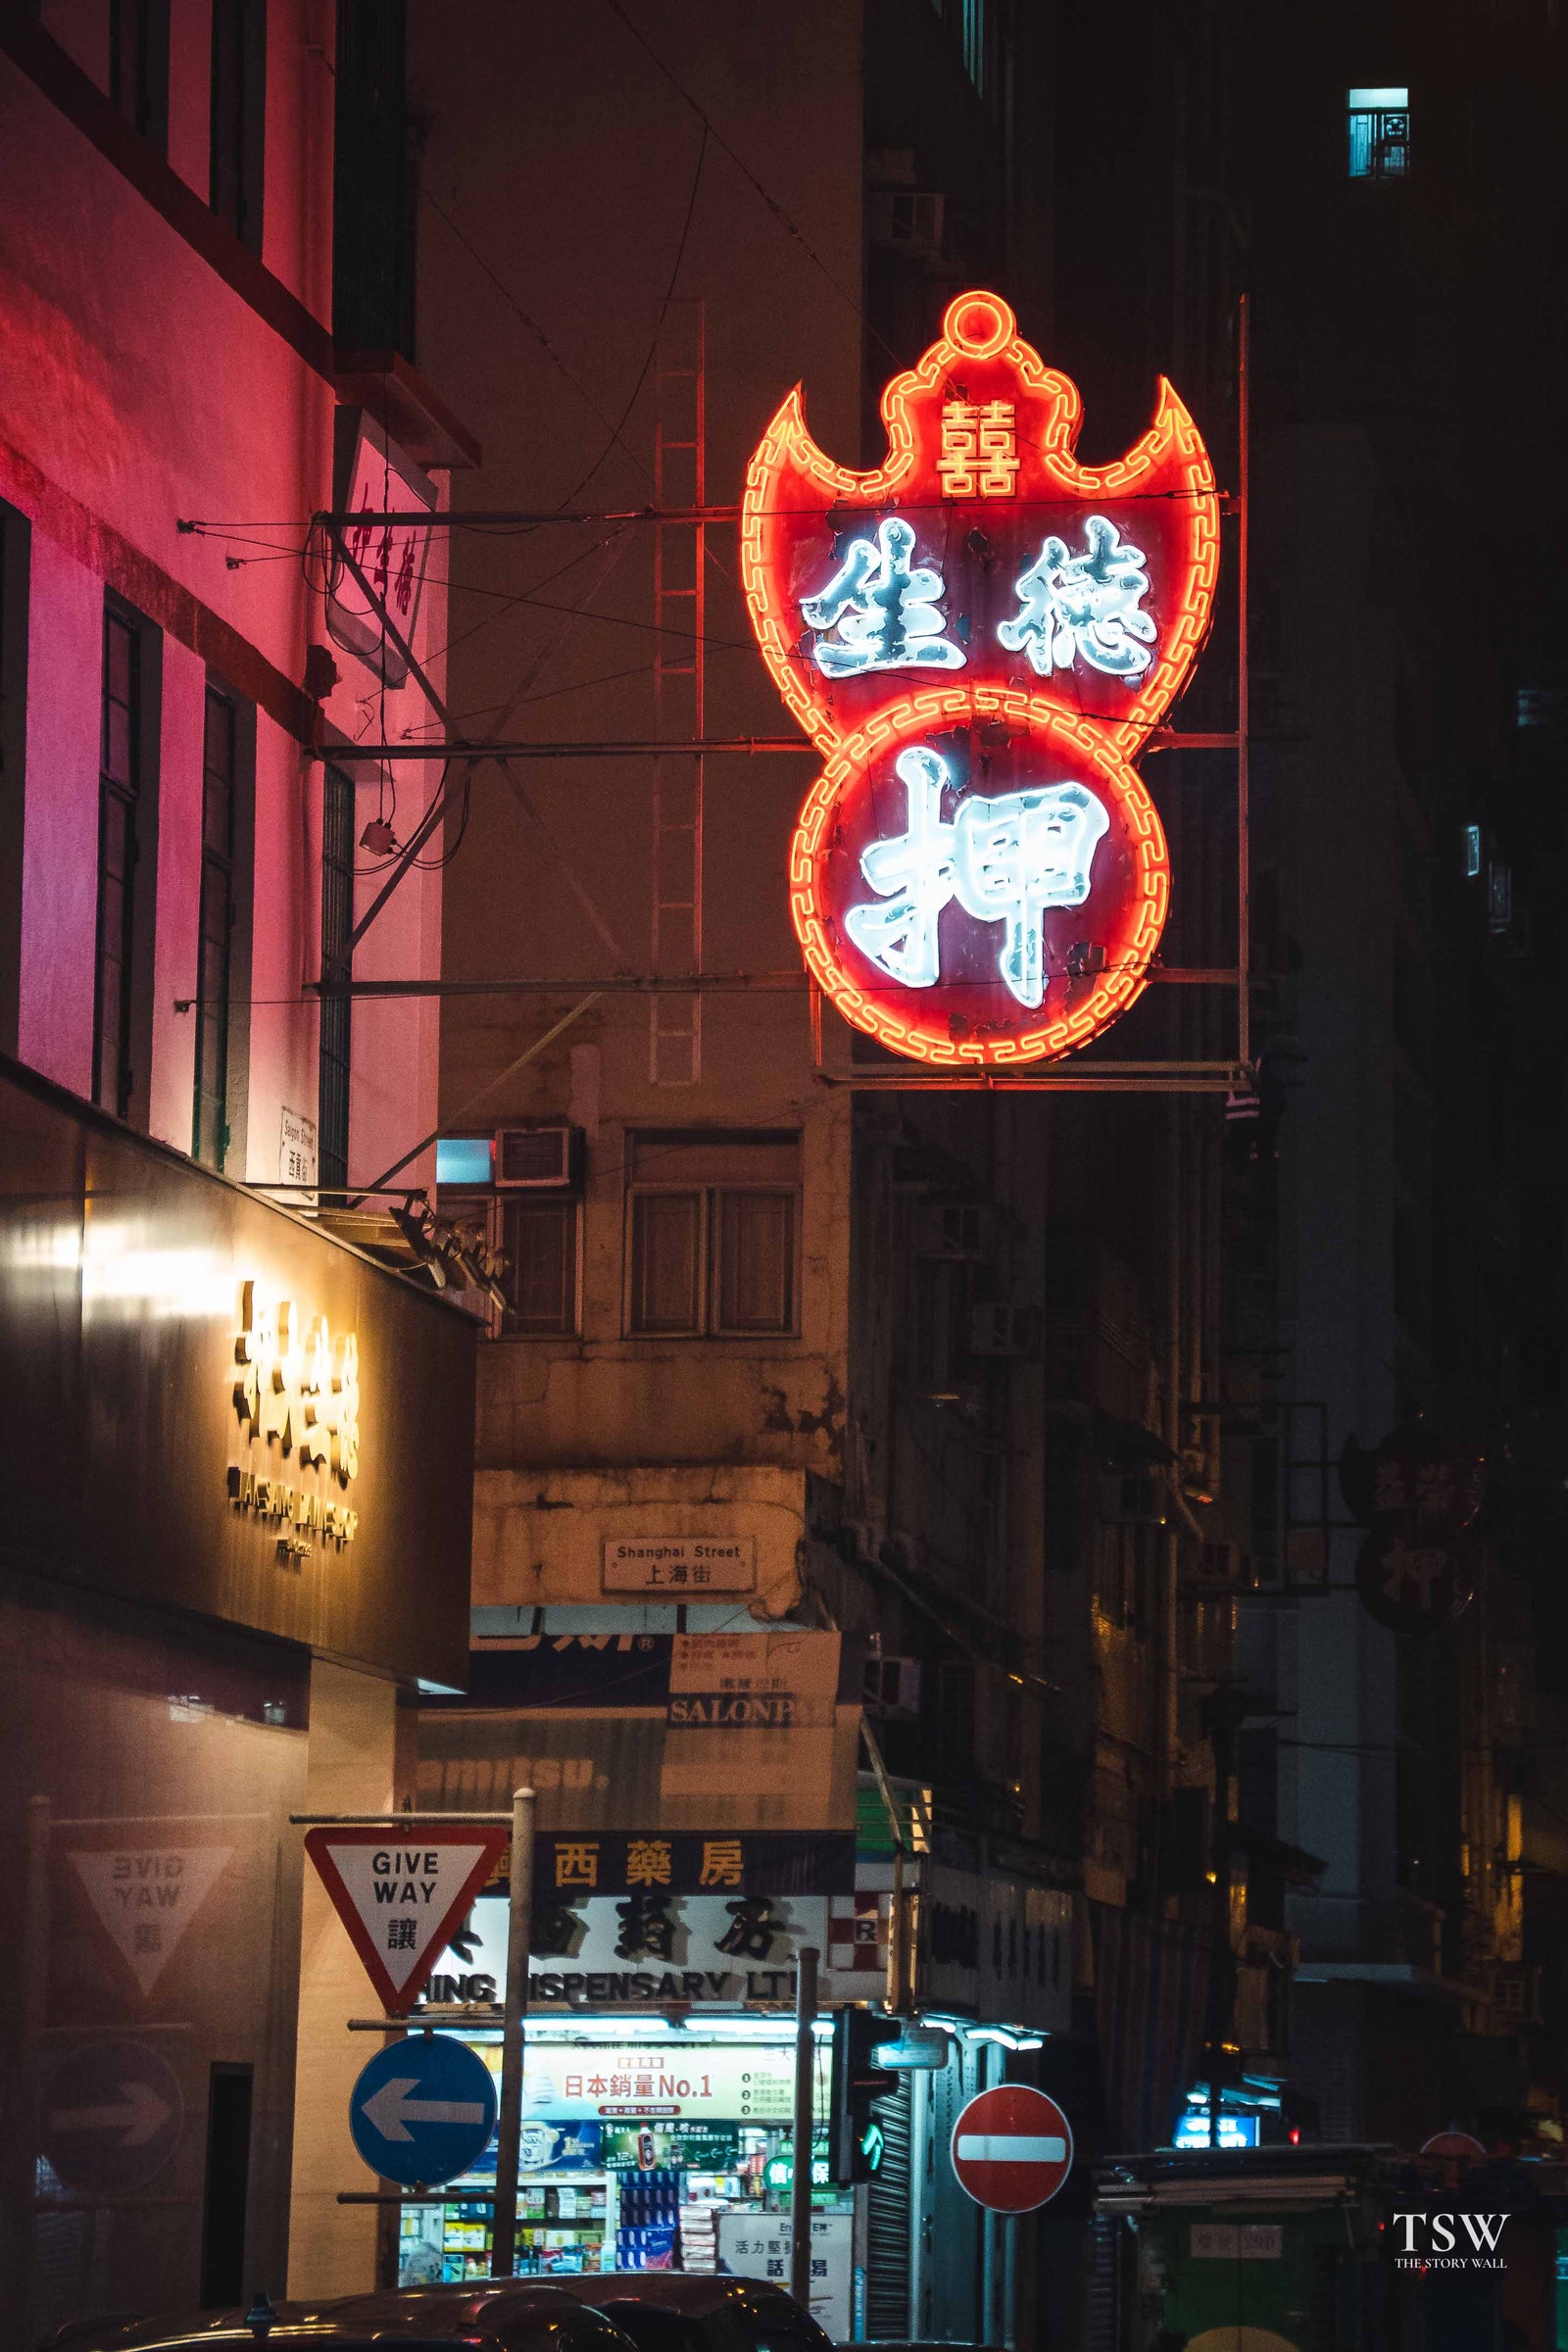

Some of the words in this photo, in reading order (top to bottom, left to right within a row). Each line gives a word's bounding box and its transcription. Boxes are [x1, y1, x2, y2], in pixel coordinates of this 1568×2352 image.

[845, 746, 1110, 1008] 押
[617, 1545, 685, 1559] Shanghai
[694, 1544, 741, 1558] Street
[646, 1565, 711, 1585] 上海街
[372, 1851, 438, 1876] GIVE
[374, 1881, 437, 1904] WAY
[387, 1918, 418, 1951] 讓
[527, 1972, 732, 2000] ISPENSARY
